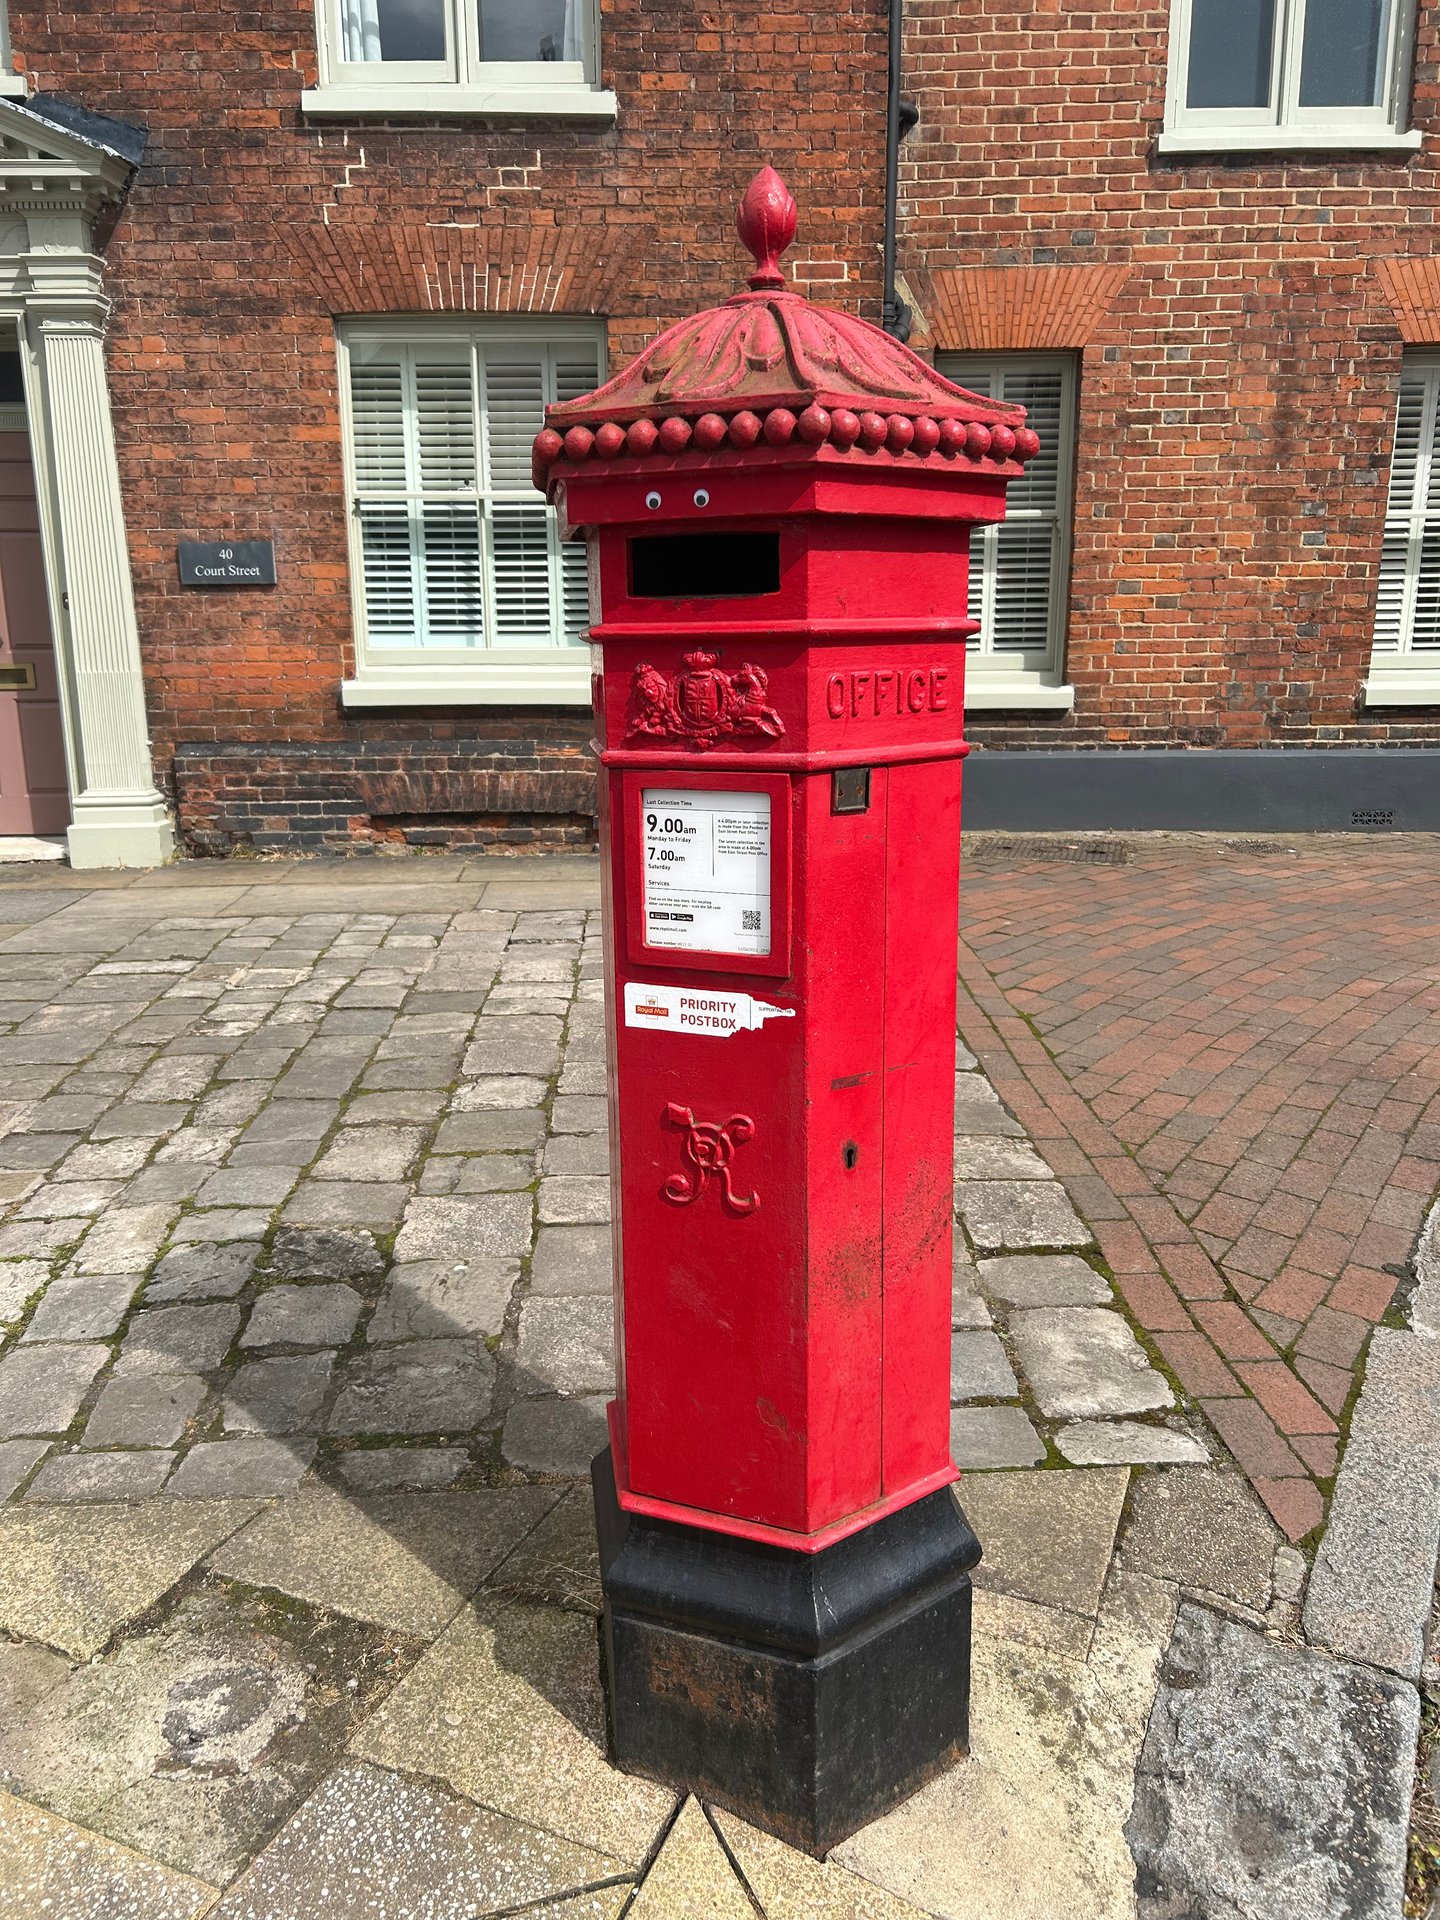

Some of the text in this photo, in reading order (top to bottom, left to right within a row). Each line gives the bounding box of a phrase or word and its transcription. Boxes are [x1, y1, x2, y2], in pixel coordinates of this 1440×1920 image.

[219, 548, 233, 560] 40
[195, 564, 260, 577] Court Street
[826, 668, 949, 719] OFFICE
[646, 814, 697, 834] 9.00am
[648, 847, 686, 862] 7.00am
[636, 1006, 654, 1014] Royal
[680, 998, 736, 1013] PRIORITY
[680, 1014, 736, 1030] POSTBOX
